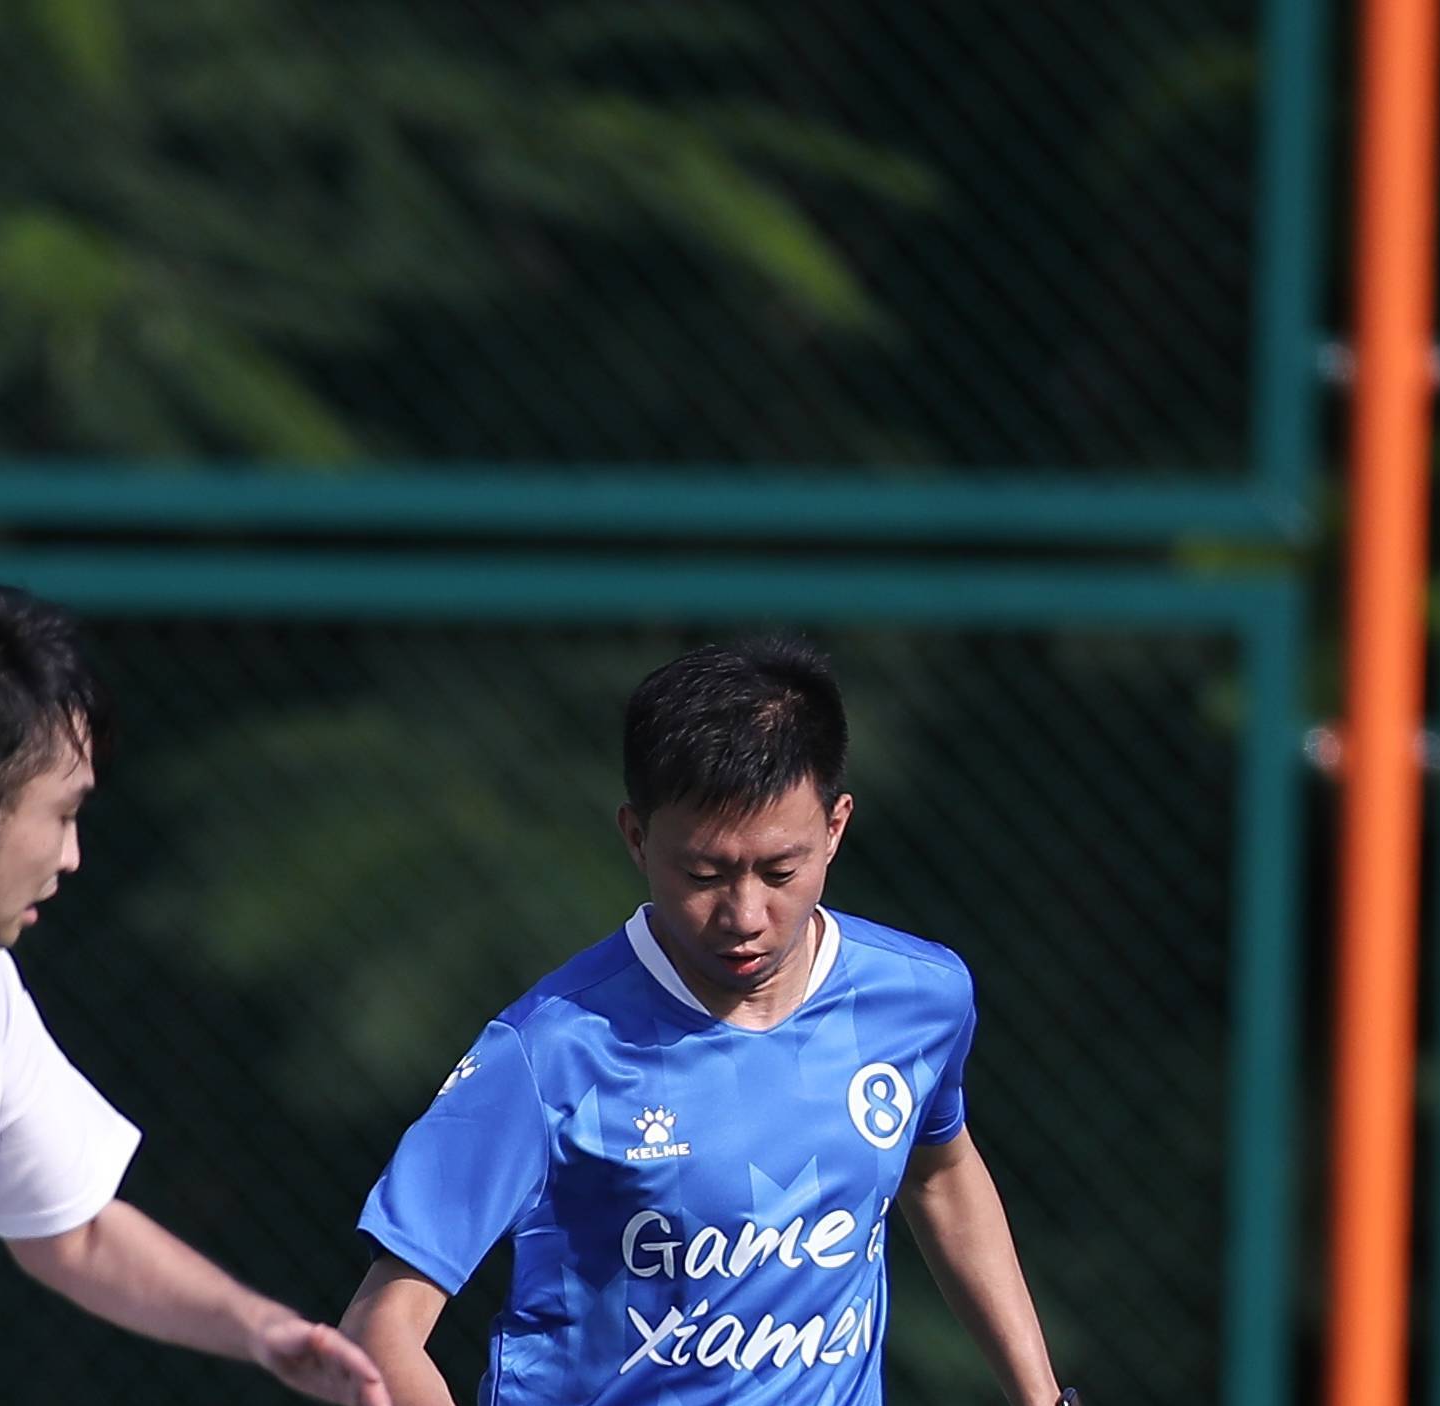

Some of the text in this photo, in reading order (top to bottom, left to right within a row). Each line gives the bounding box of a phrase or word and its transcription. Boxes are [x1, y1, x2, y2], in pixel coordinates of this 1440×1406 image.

[862, 1073, 903, 1138] 8
[625, 1143, 691, 1161] KELME
[621, 1208, 856, 1279] Game
